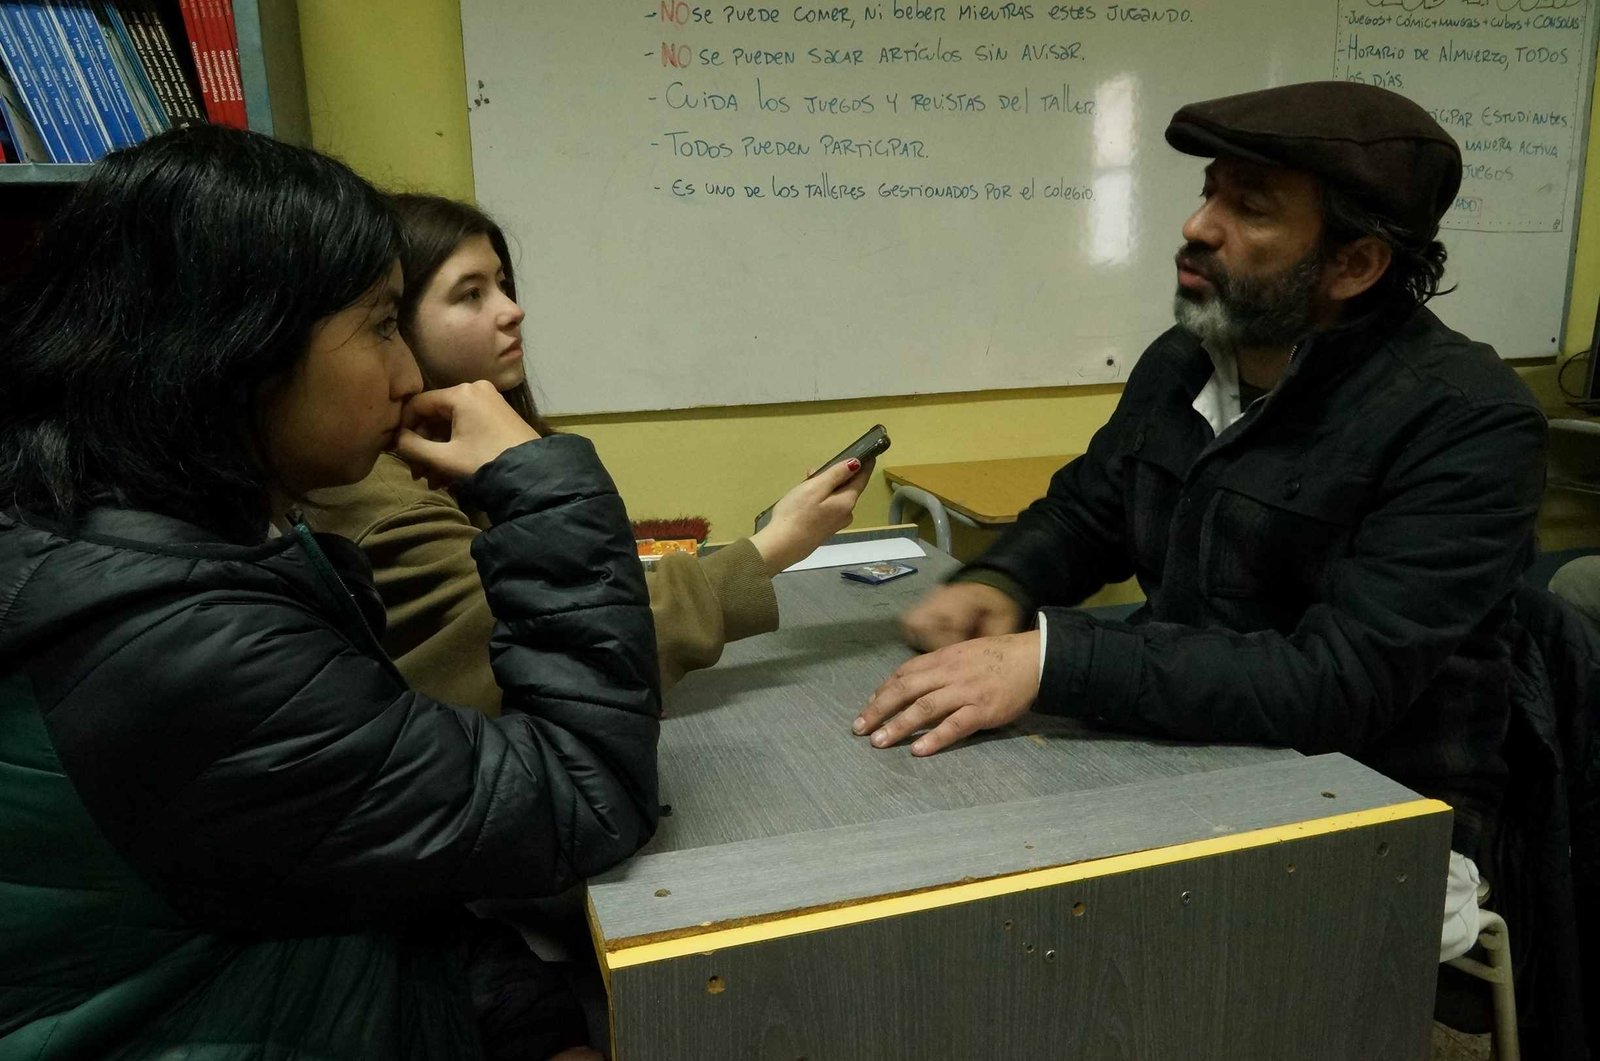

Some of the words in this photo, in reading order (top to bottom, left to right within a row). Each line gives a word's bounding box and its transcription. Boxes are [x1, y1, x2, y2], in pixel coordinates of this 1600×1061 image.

[661, 0, 689, 24] NO
[190, 41, 208, 92] Emprendimiento
[202, 51, 219, 102] Emprendimiento
[209, 50, 227, 100] Emprendimiento
[218, 50, 235, 100] Emprendimiento
[225, 49, 243, 100] Emprendimiento
[662, 42, 692, 68] NO
